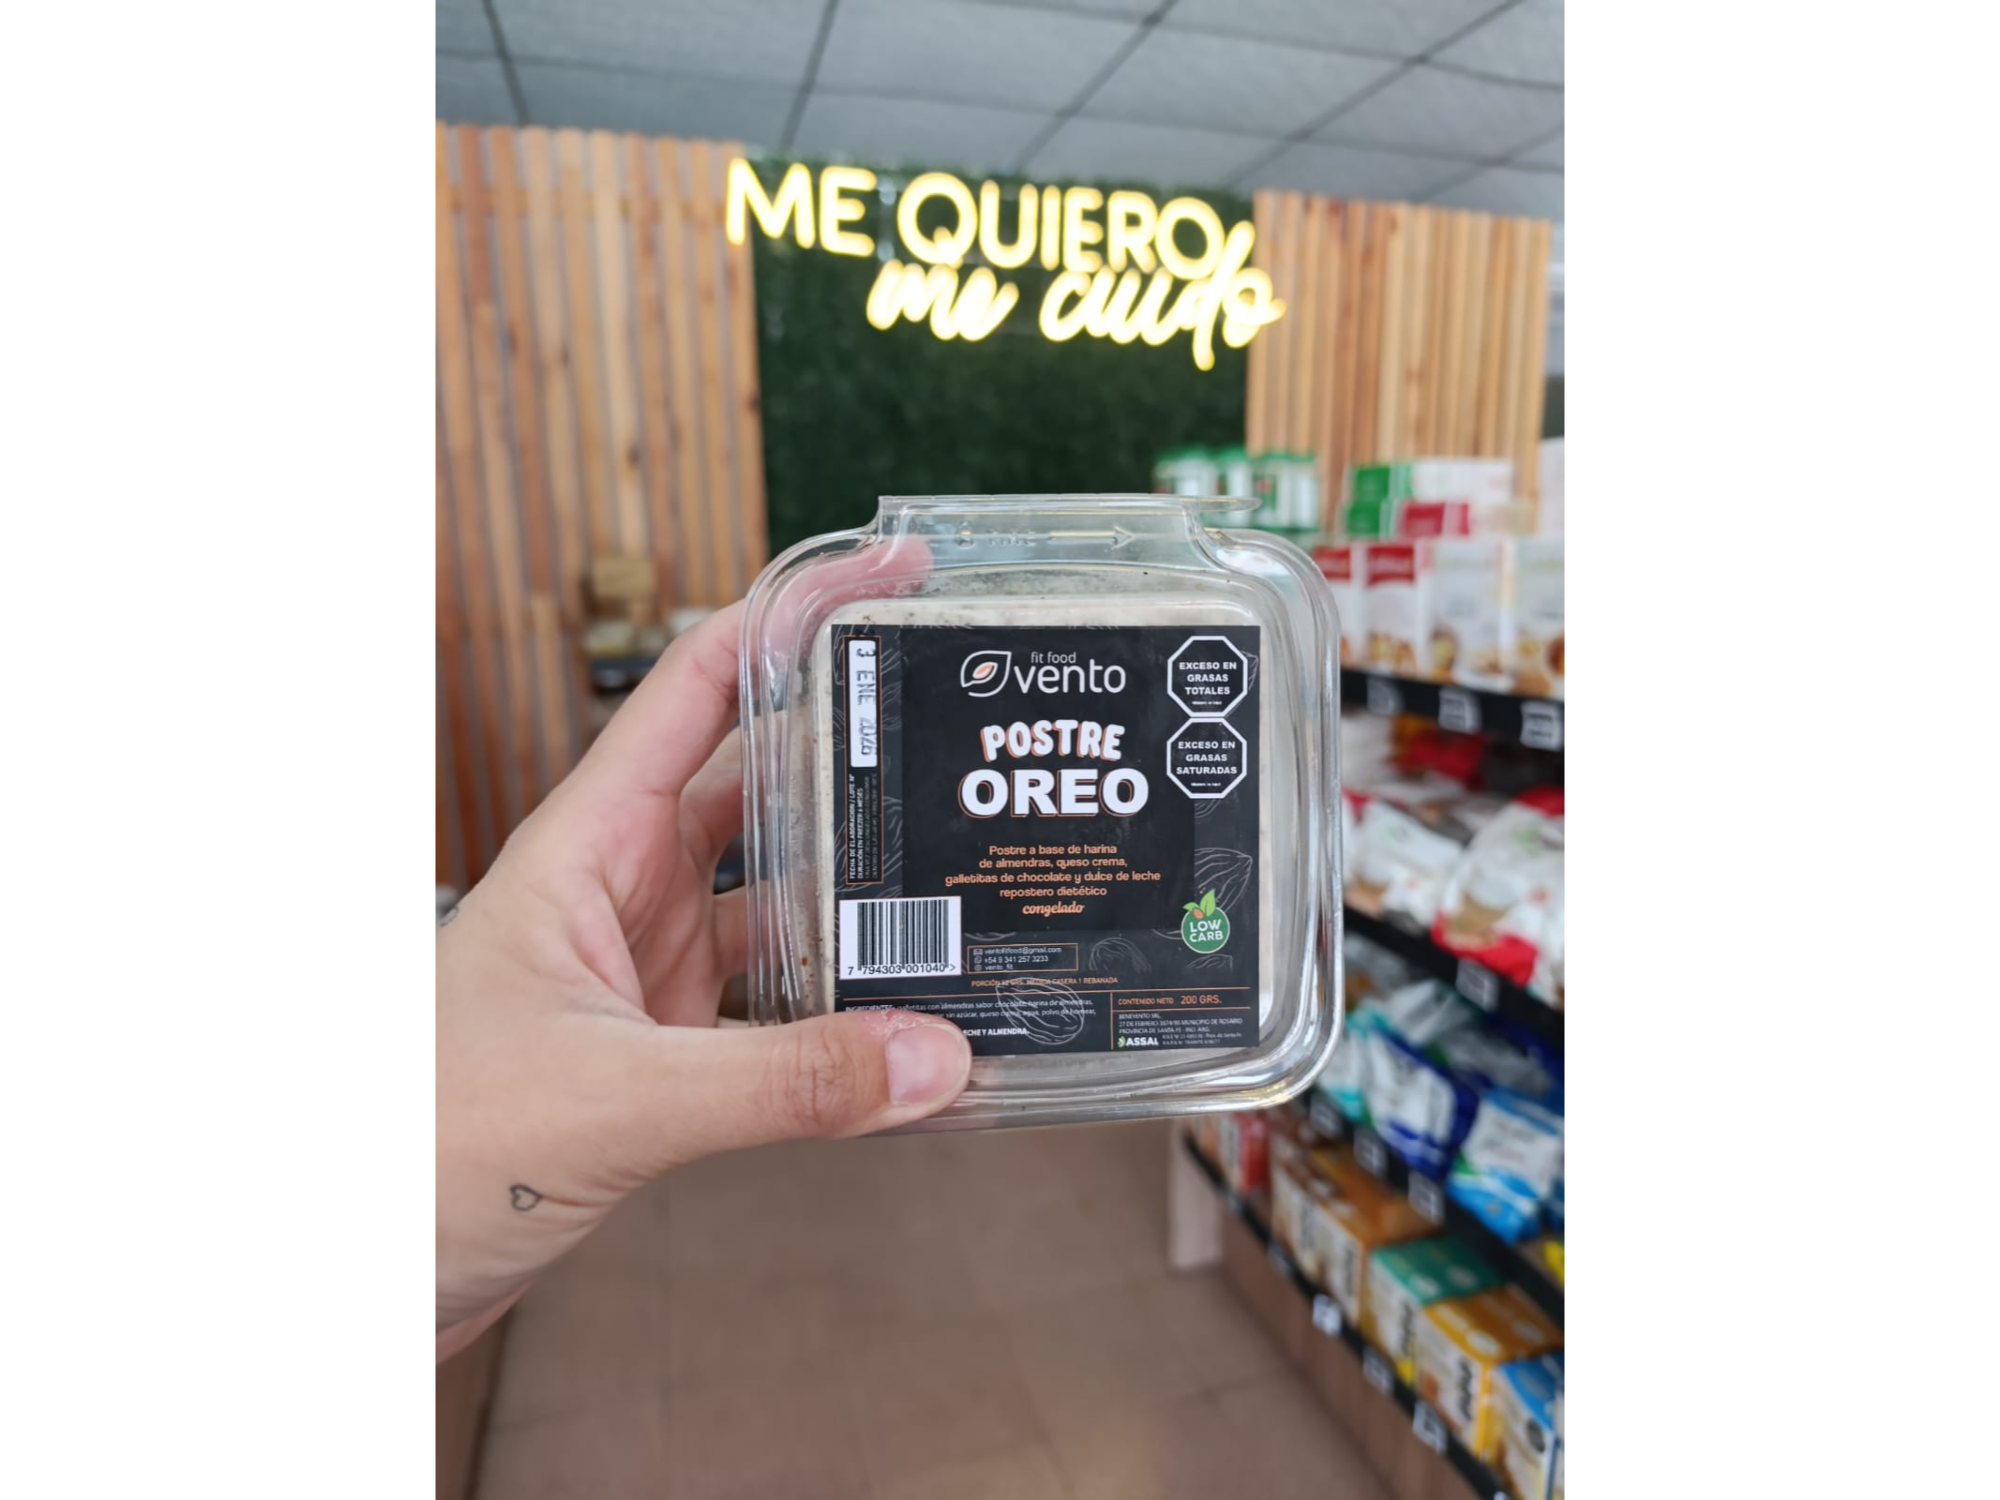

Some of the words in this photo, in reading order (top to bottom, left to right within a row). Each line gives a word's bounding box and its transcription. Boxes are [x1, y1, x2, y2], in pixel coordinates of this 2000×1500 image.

[727, 157, 877, 257] ME
[897, 172, 1226, 281] QUIERO
[866, 259, 1019, 341] me
[1031, 651, 1044, 664] fit
[1047, 651, 1077, 664] food
[1178, 661, 1220, 670] EXCESO
[1222, 661, 1237, 670] EN
[1013, 658, 1127, 694] vento
[1186, 674, 1229, 683] GRASAS
[856, 670, 877, 705] ENE
[1184, 686, 1231, 695] TOTALES
[980, 719, 1126, 763] POSTRE
[1177, 741, 1219, 749] EXCESO
[1221, 741, 1236, 749] EN
[1185, 754, 1228, 762] GRASAS
[1175, 766, 1238, 775] SATURADAS
[957, 767, 1149, 819] OREO
[989, 845, 1027, 855] Postre
[1029, 847, 1036, 855] a
[1038, 845, 1065, 854] base
[1067, 845, 1081, 854] de
[1084, 844, 1118, 854] harina
[979, 859, 993, 868] de
[996, 858, 1054, 868] almendras,
[1056, 859, 1090, 869] queso
[1092, 858, 1128, 867] crema,
[945, 873, 998, 887] galletitas
[1000, 873, 1015, 882] de
[1016, 872, 1072, 882] chocolate
[1074, 873, 1081, 884] y
[1084, 871, 1113, 881] dulce
[1115, 871, 1130, 881] de
[1132, 870, 1162, 881] leche
[999, 887, 1055, 900] repostero
[1056, 885, 1107, 896] dietético
[1022, 901, 1085, 917] congelado
[1190, 919, 1222, 932] LOW
[1190, 931, 1223, 942] CARB
[984, 956, 997, 964] +54
[1017, 955, 1031, 963] 257
[1032, 955, 1049, 963] 3233
[847, 966, 854, 975] 7
[862, 964, 902, 975] 794303
[905, 963, 946, 973] 001040
[1118, 997, 1156, 1005] CONTENIDO
[1180, 995, 1197, 1004] 200
[1199, 994, 1223, 1004] GRS.
[982, 1028, 987, 1036] Y
